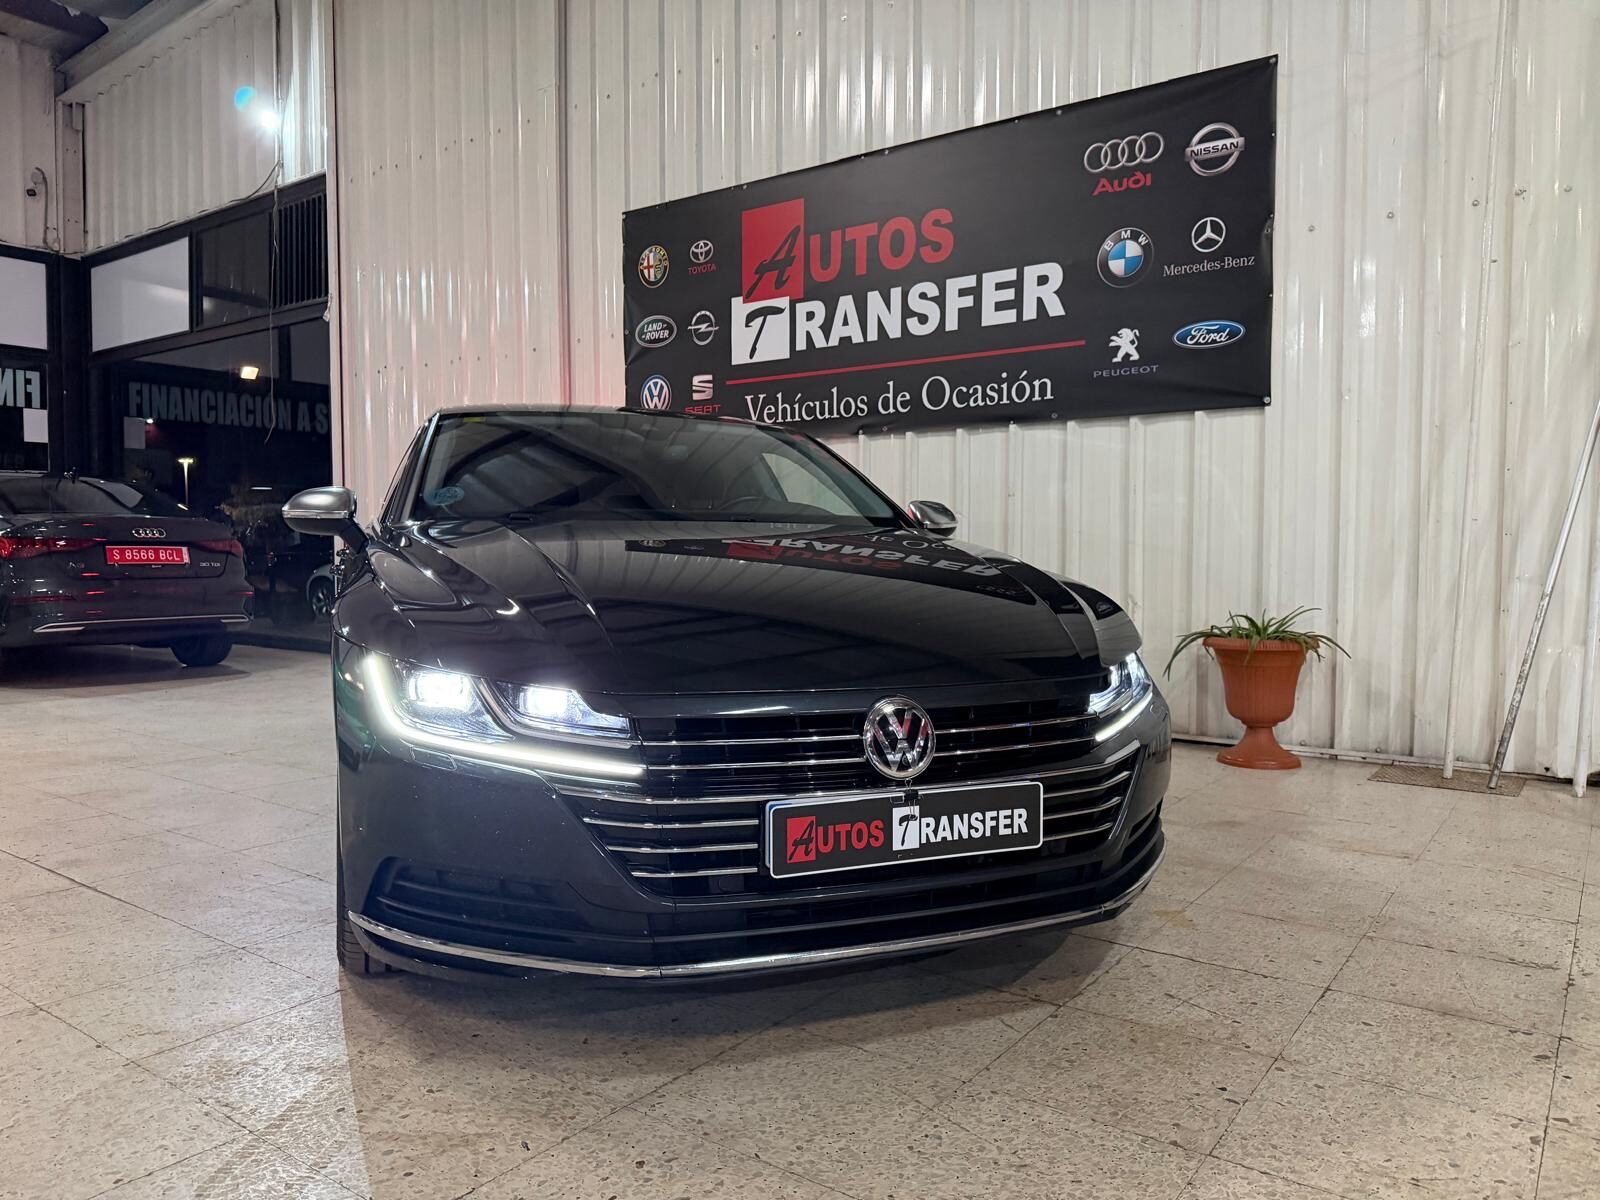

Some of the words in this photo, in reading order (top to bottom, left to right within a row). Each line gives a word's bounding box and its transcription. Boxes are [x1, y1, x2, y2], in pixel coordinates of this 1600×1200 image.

[1188, 140, 1240, 158] NISSAN
[1092, 171, 1152, 196] Audi
[1103, 230, 1149, 251] BMW
[745, 207, 955, 300] AUTOS
[687, 263, 717, 275] TOYOTA
[1163, 254, 1255, 277] Mercedes-Benz
[744, 261, 1066, 360] TRANSFER
[1186, 324, 1230, 345] Ford
[1092, 364, 1159, 378] PEUGEOT
[744, 385, 868, 424] Vehículos
[878, 381, 911, 414] de
[921, 370, 1054, 410] Ocasión
[113, 549, 120, 560] S
[160, 549, 180, 560] BCL
[788, 819, 885, 861] AUTOS
[898, 807, 1028, 847] TRANSFER
